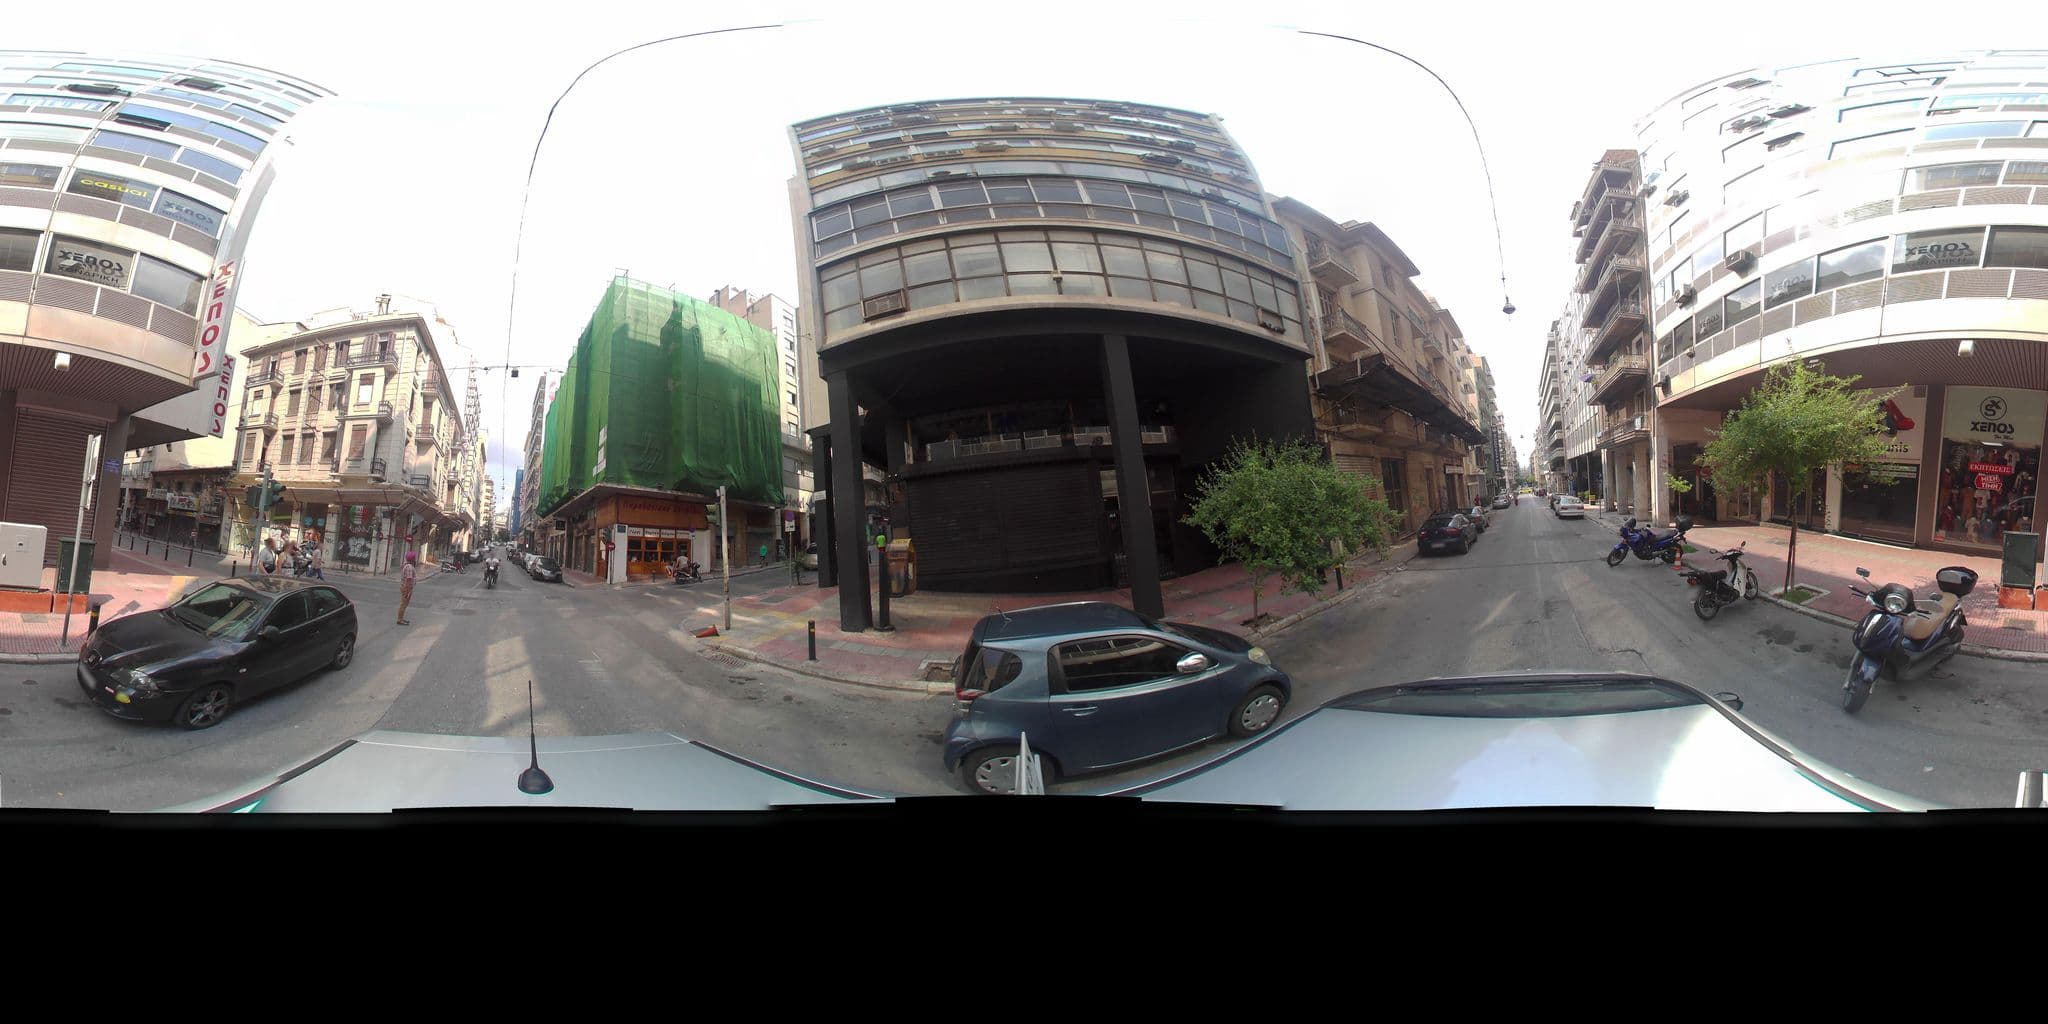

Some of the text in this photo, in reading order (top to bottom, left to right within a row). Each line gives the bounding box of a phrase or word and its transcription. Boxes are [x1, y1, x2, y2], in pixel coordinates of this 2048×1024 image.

[80, 178, 148, 198] casual
[198, 261, 234, 373] XENOS
[212, 354, 234, 433] XENOS
[1970, 421, 2015, 434] XENOS
